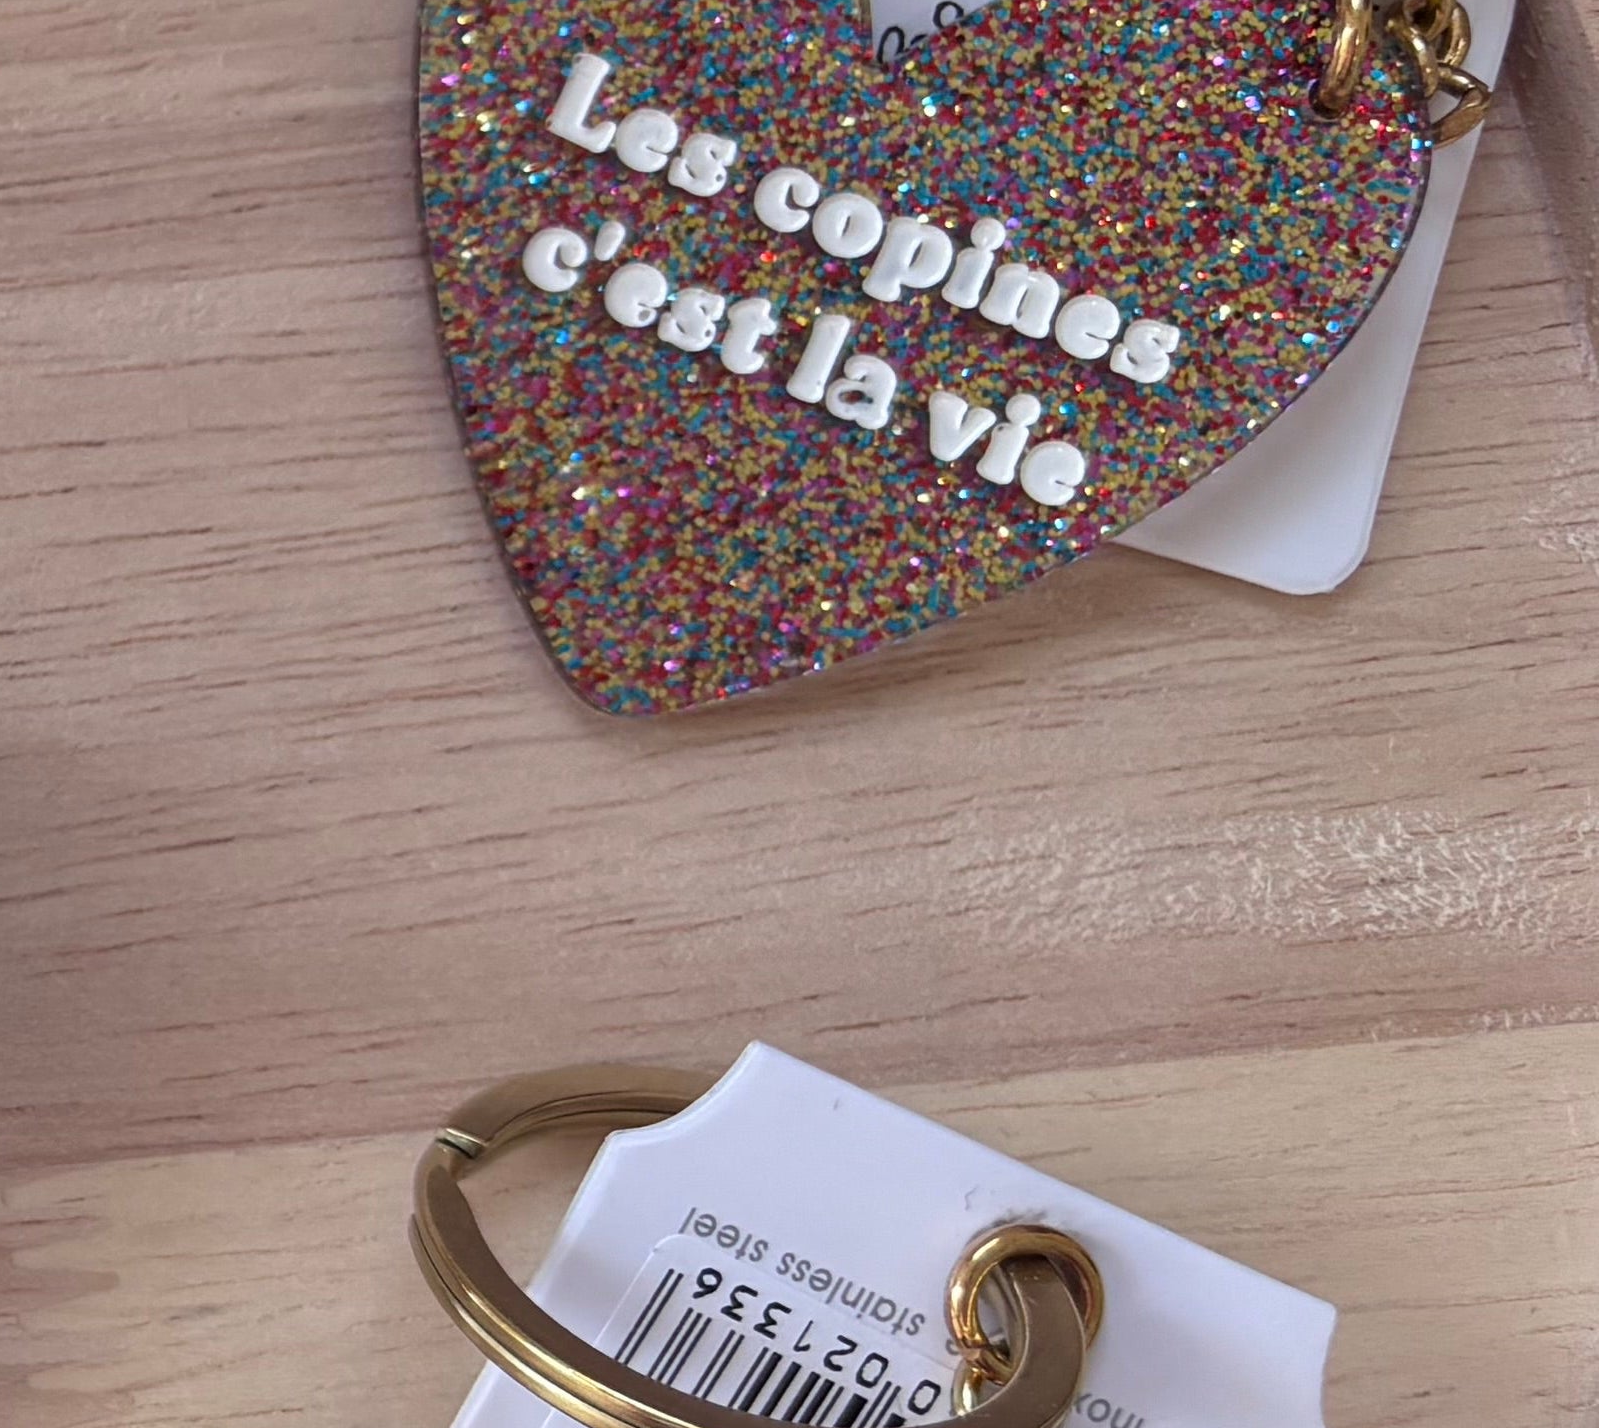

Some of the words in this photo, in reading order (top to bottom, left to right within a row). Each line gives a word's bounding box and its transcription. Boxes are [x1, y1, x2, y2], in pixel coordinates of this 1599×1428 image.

[546, 52, 738, 197] Les
[753, 167, 1180, 384] copines
[521, 220, 778, 374] c'est
[786, 313, 898, 431] la
[928, 390, 1087, 507] vie
[677, 1206, 770, 1270] steel
[775, 1251, 928, 1341] stainless
[691, 1265, 888, 1391] 021336
